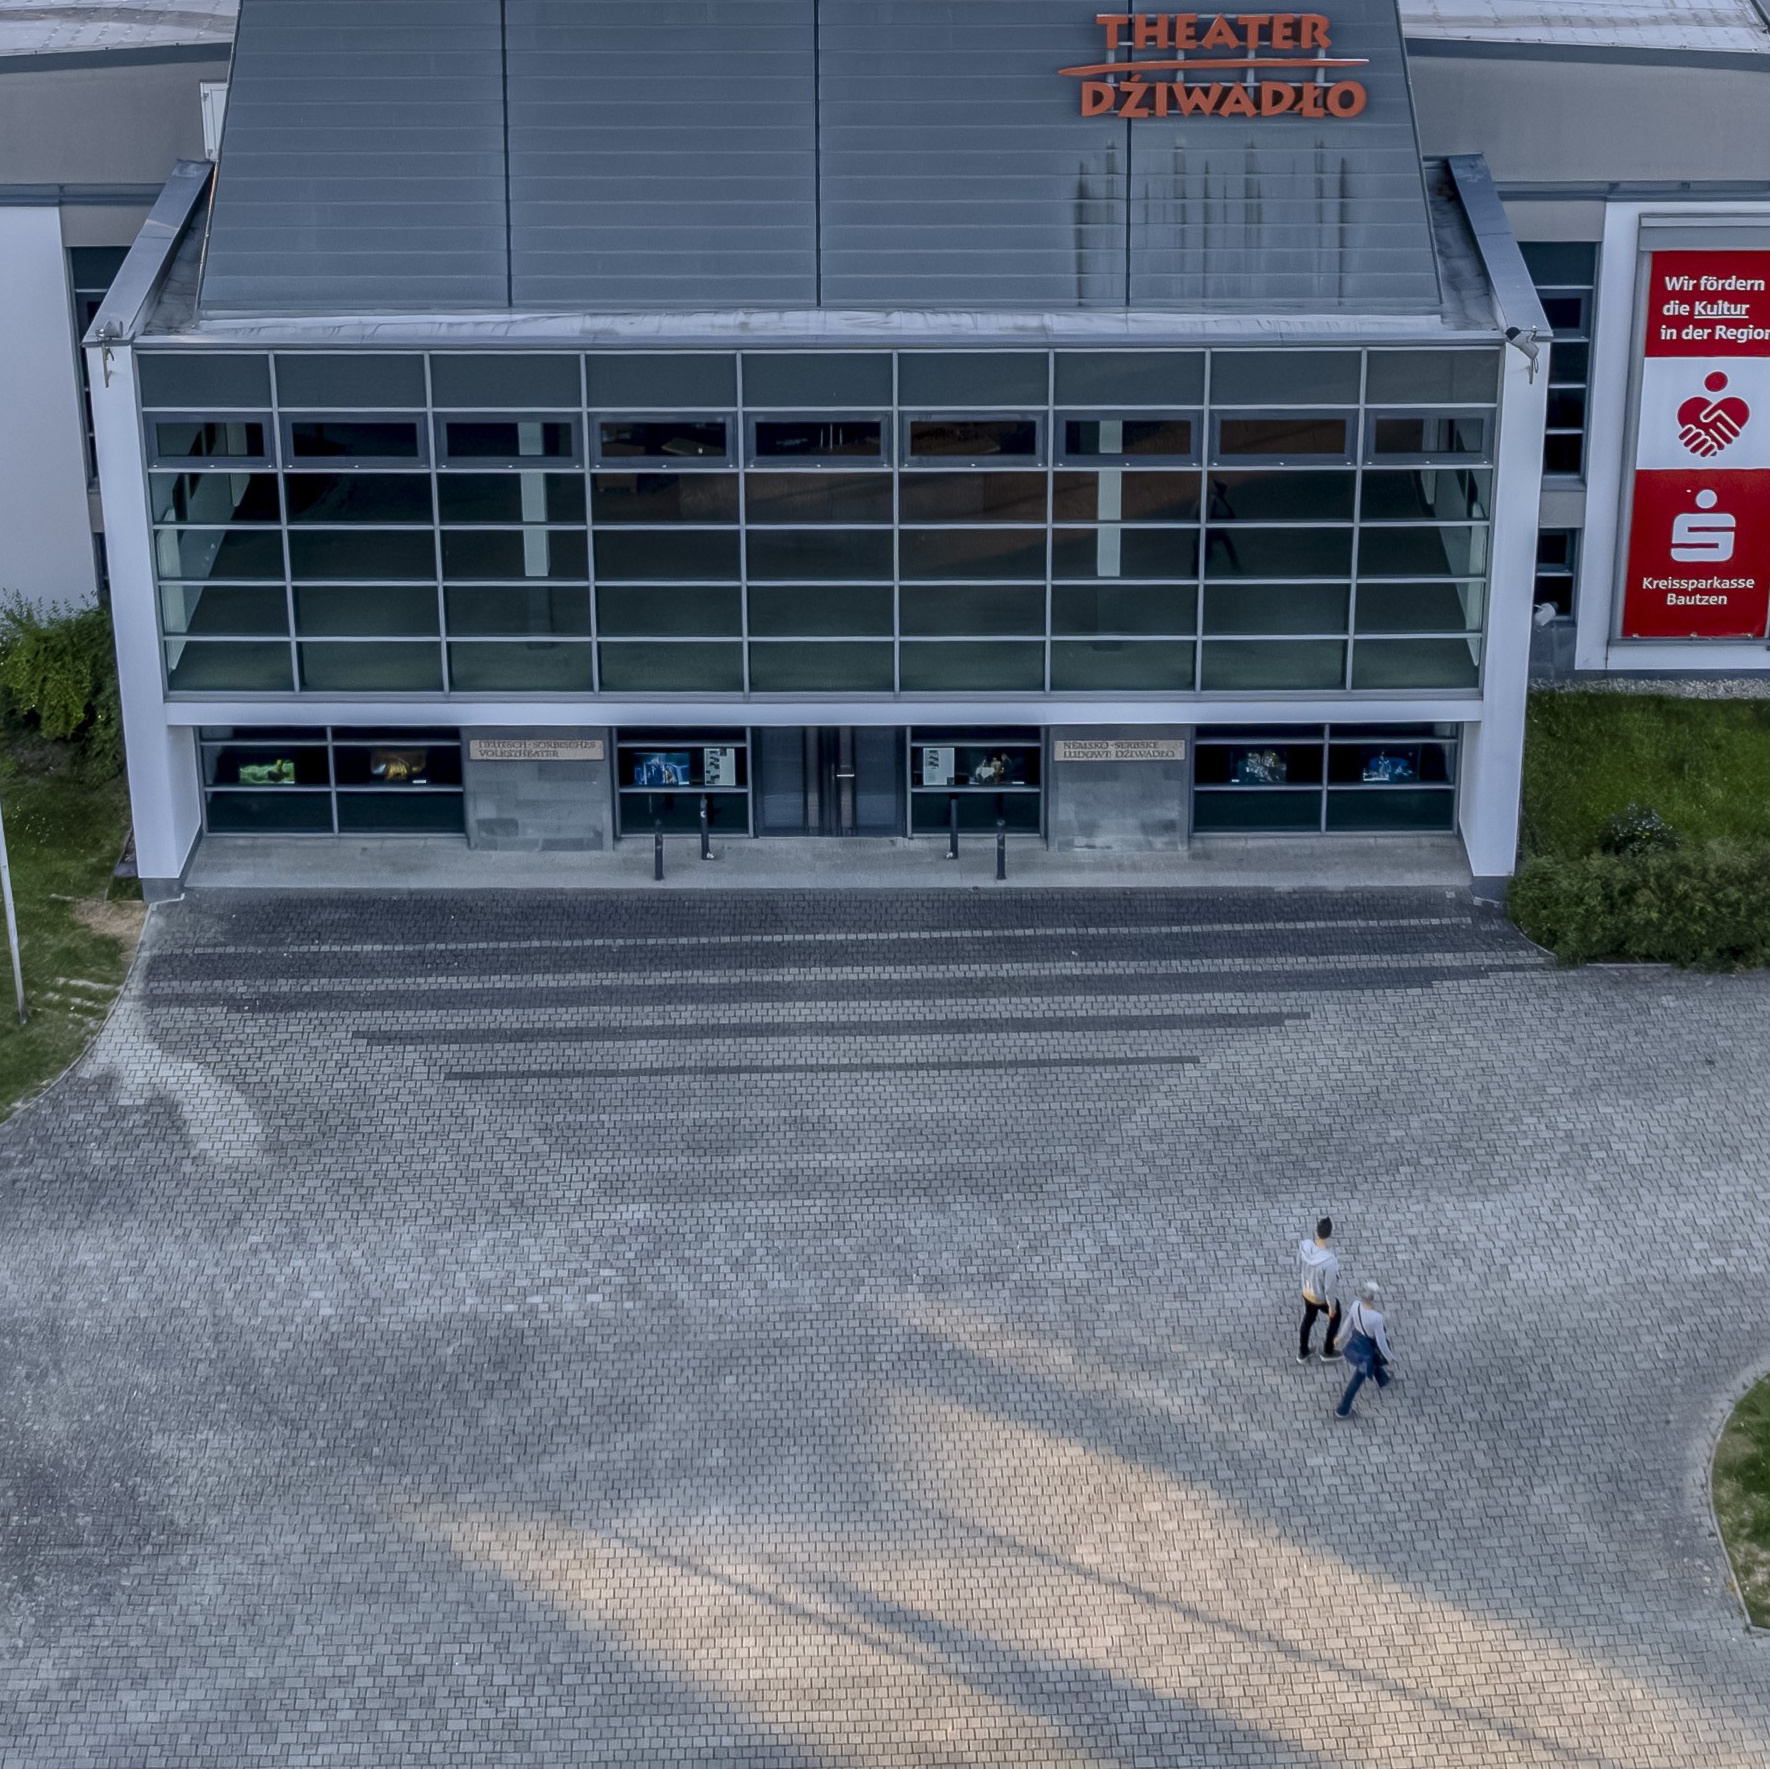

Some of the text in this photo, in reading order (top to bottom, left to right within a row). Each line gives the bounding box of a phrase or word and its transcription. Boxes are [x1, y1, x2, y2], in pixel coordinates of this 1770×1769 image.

[1096, 13, 1332, 49] THEATER
[1081, 74, 1368, 118] DŹIWADŁO
[1665, 276, 1765, 291] Wir fördern
[1662, 300, 1750, 318] die Kultur
[1660, 325, 1677, 340] in
[1681, 325, 1712, 340] der
[1642, 576, 1756, 591] Kreissparkasse
[1666, 593, 1728, 606] Bautzen
